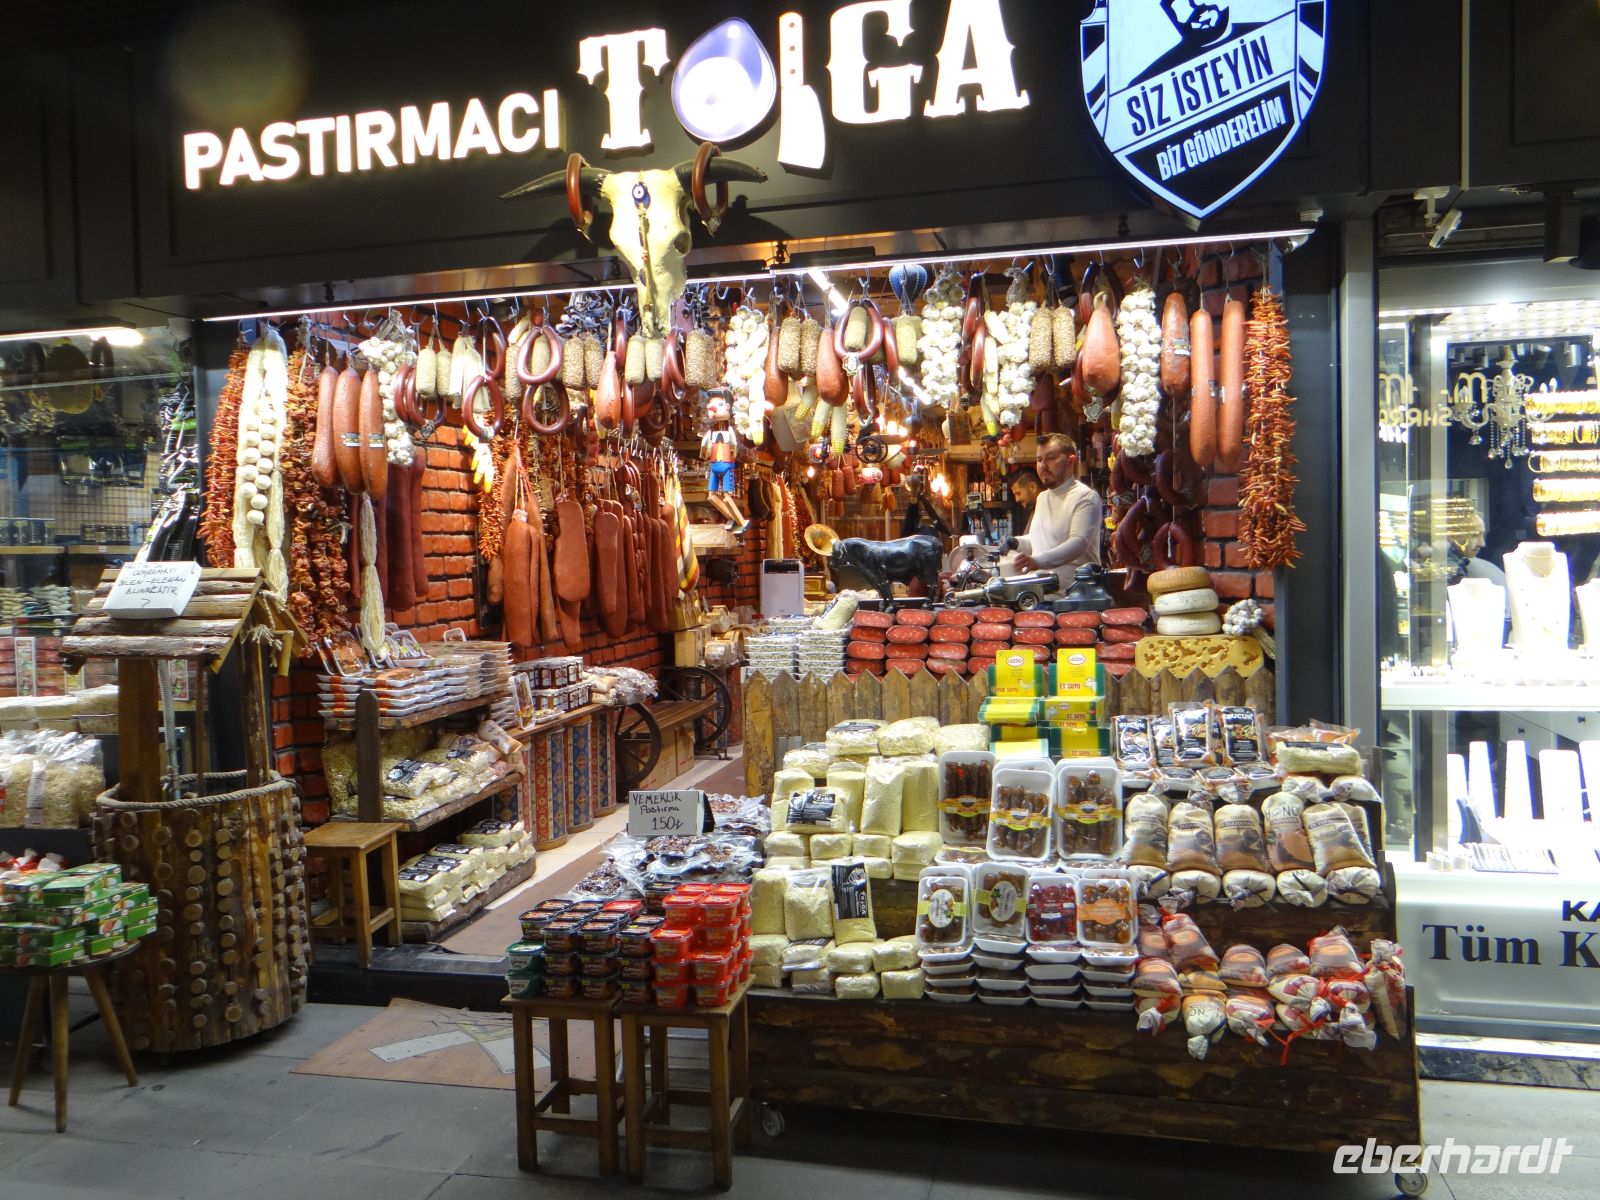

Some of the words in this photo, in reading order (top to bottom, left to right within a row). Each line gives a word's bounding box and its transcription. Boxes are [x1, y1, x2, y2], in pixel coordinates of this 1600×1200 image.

[1127, 85, 1171, 136] SİZ
[1171, 35, 1274, 116] İSTEYİN
[184, 89, 560, 189] PASTIRMACI
[1156, 143, 1185, 181] BİZ
[1185, 96, 1287, 168] GÖNDERELİM
[1422, 924, 1541, 965] Tüm
